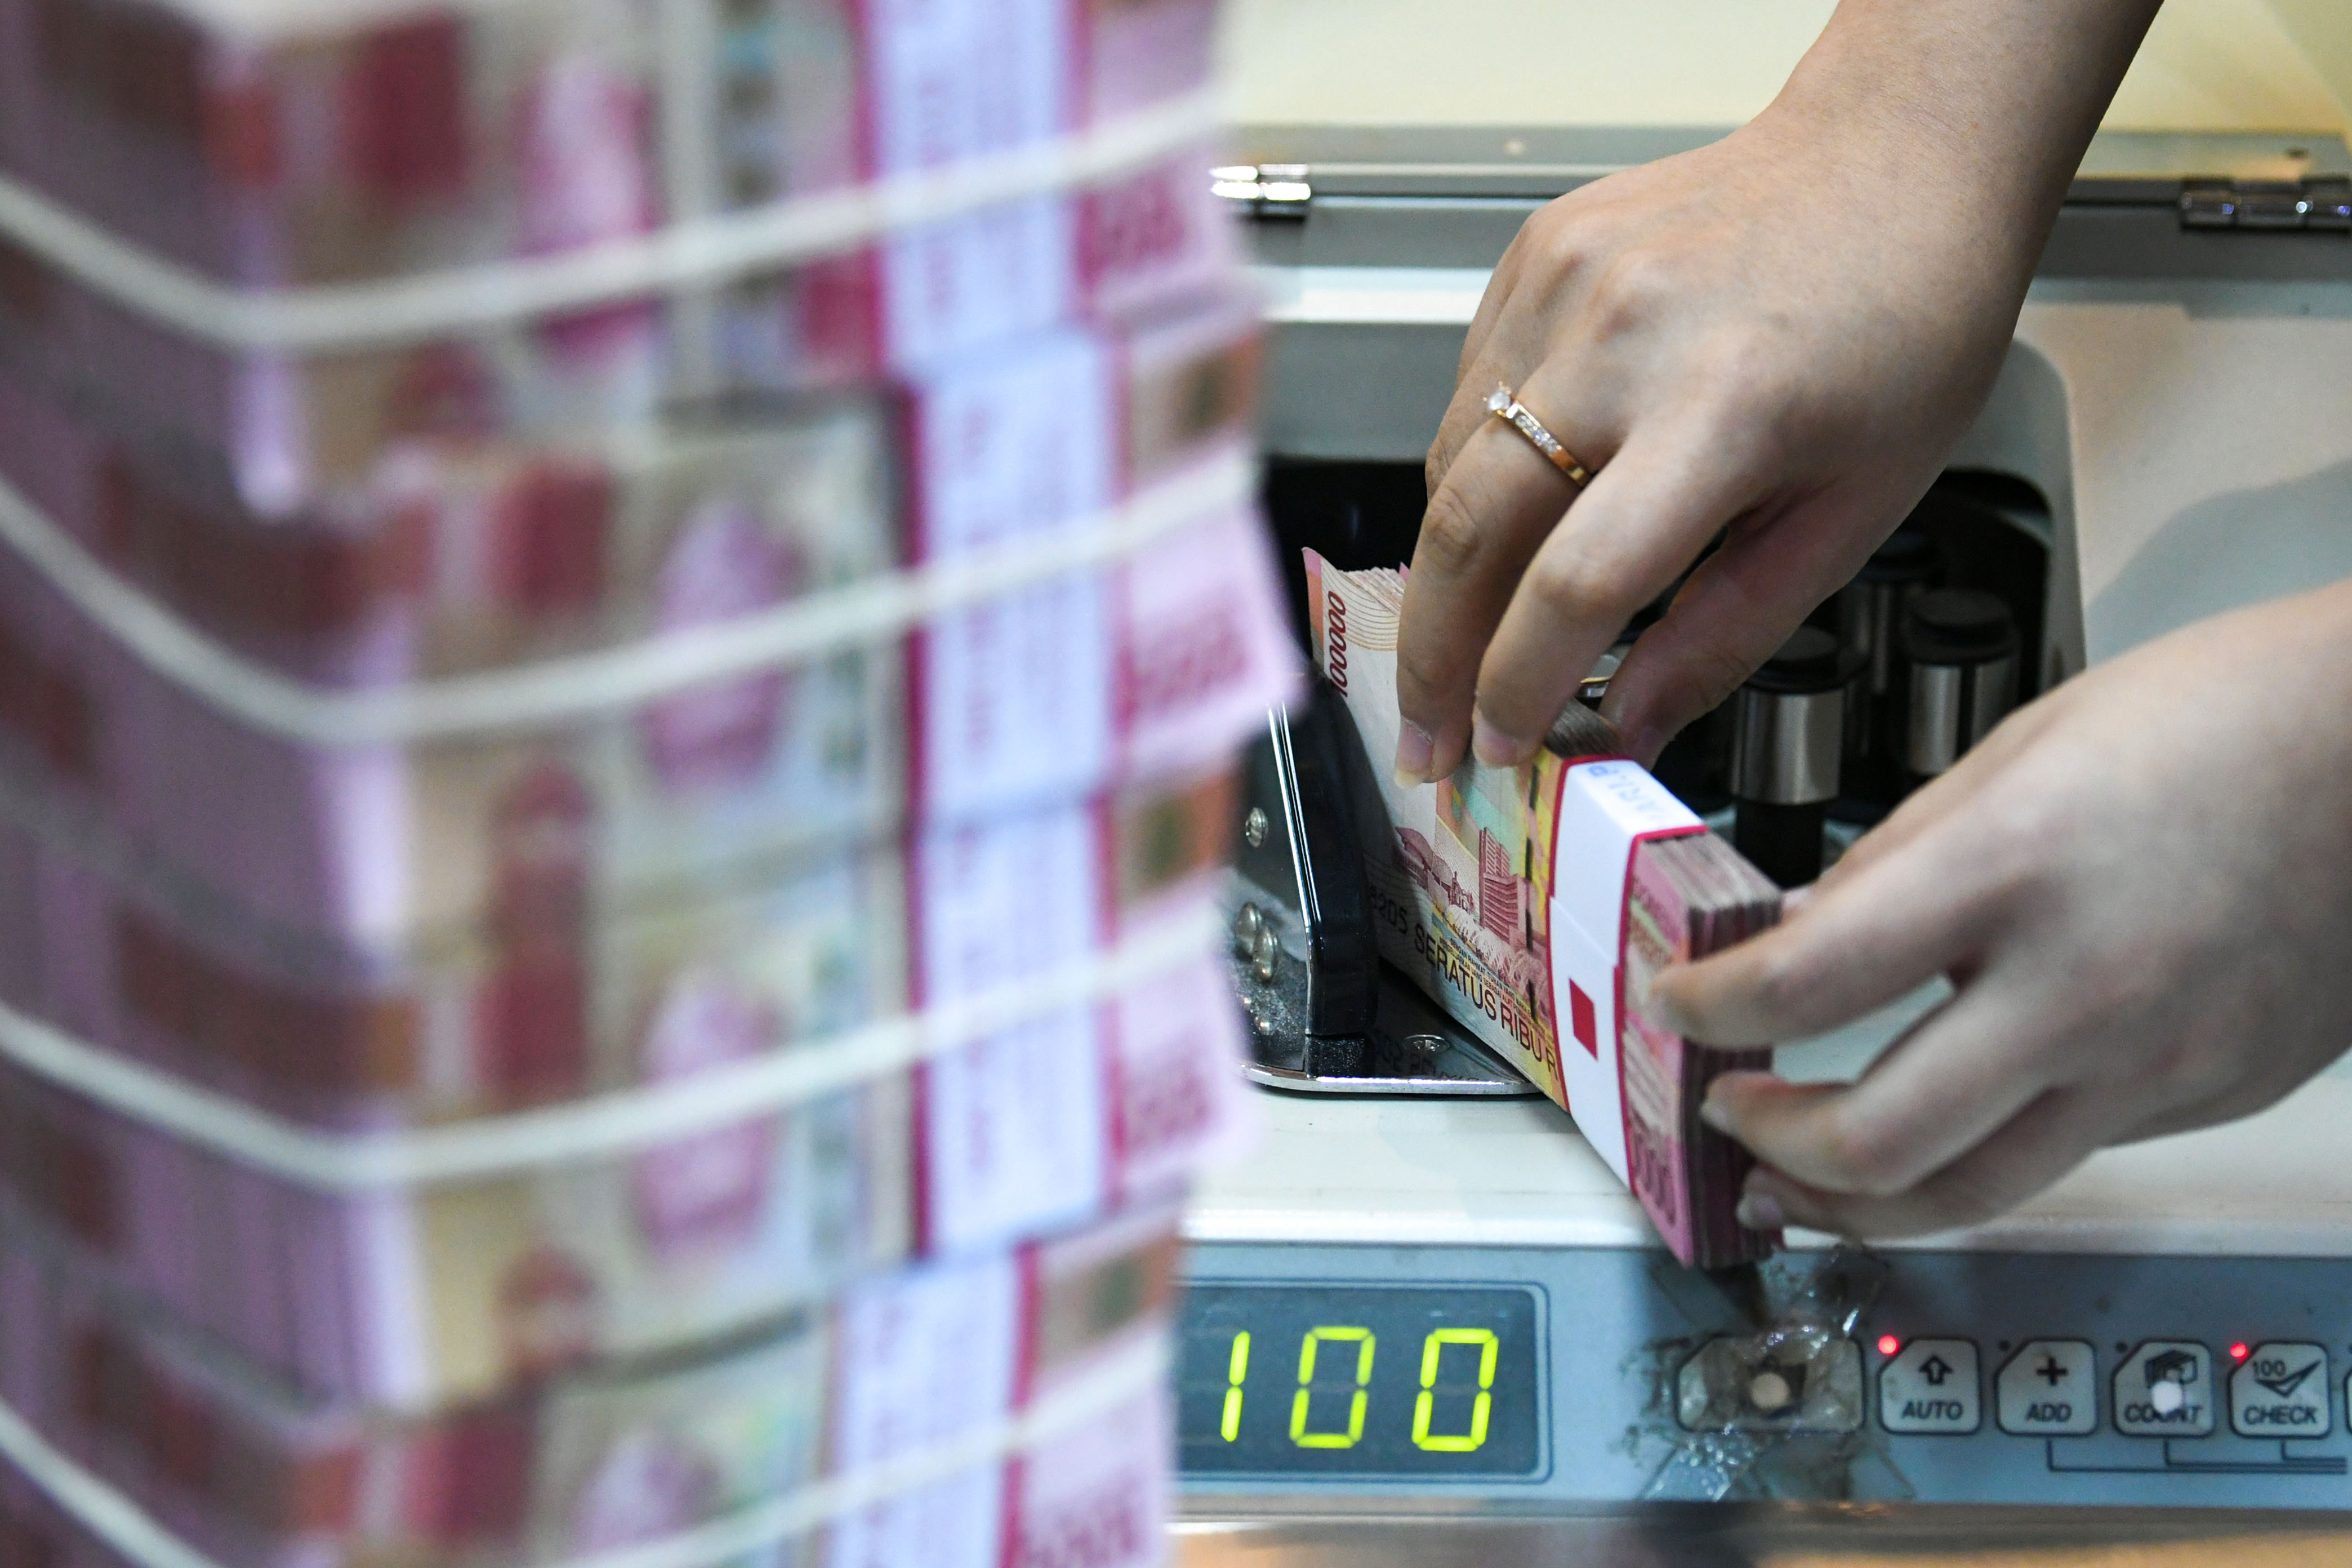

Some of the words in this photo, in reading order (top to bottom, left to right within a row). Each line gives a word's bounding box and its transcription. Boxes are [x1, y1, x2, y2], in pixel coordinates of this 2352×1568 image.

[1328, 590, 1348, 698] 100000
[1414, 923, 1497, 1021] SERATUS
[1500, 1001, 1543, 1062] RIBU
[1220, 1326, 1499, 1451] 100
[1901, 1401, 1964, 1420] AUTO
[2025, 1403, 2073, 1423] ADD
[2244, 1406, 2317, 1424] CHECK
